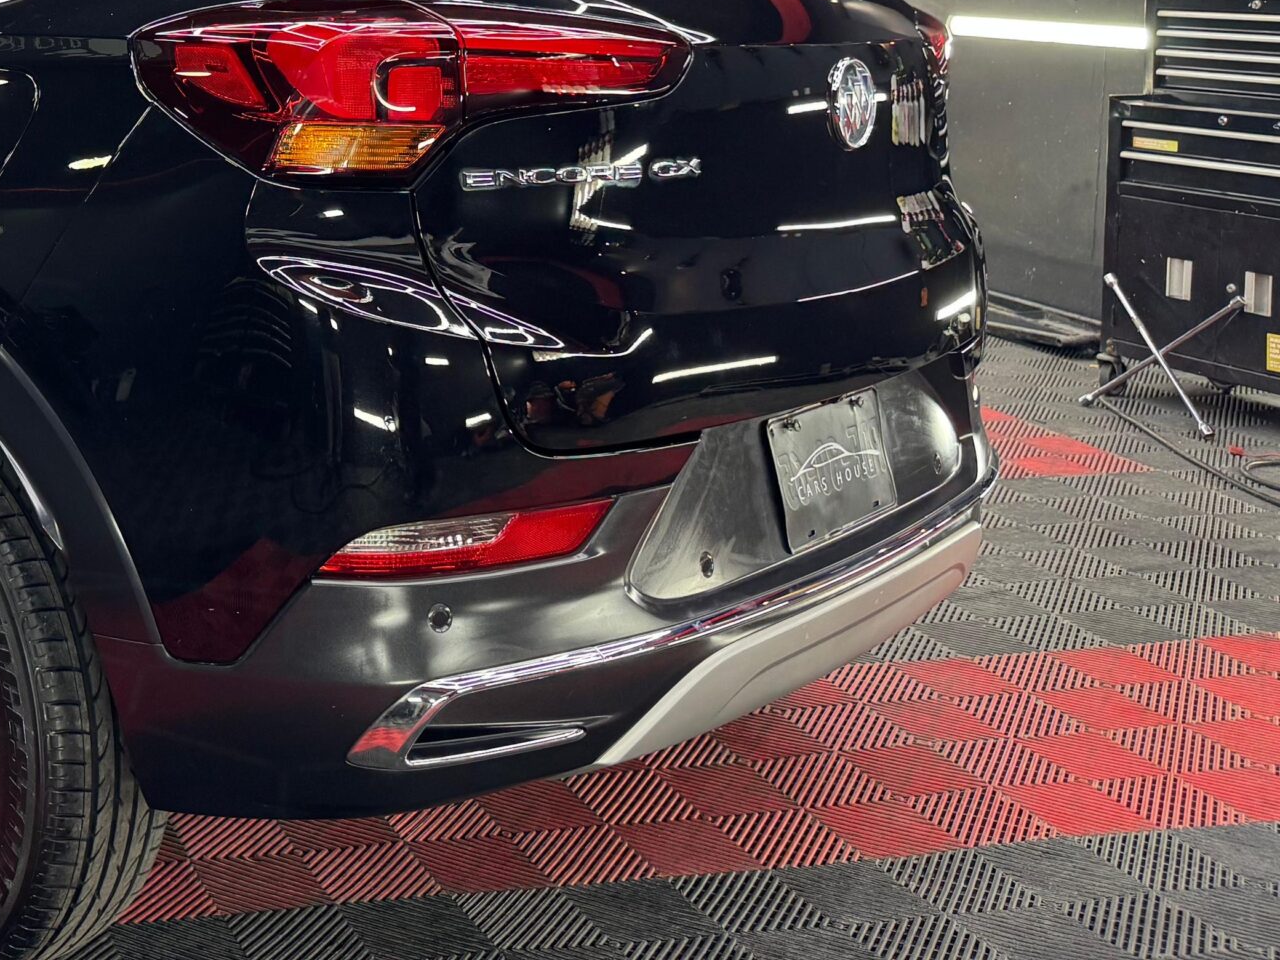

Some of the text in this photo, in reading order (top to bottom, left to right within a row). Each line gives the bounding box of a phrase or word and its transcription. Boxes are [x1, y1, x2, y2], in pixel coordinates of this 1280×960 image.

[460, 158, 701, 190] ENCORE GX
[797, 459, 875, 500] CARS HOUSE
